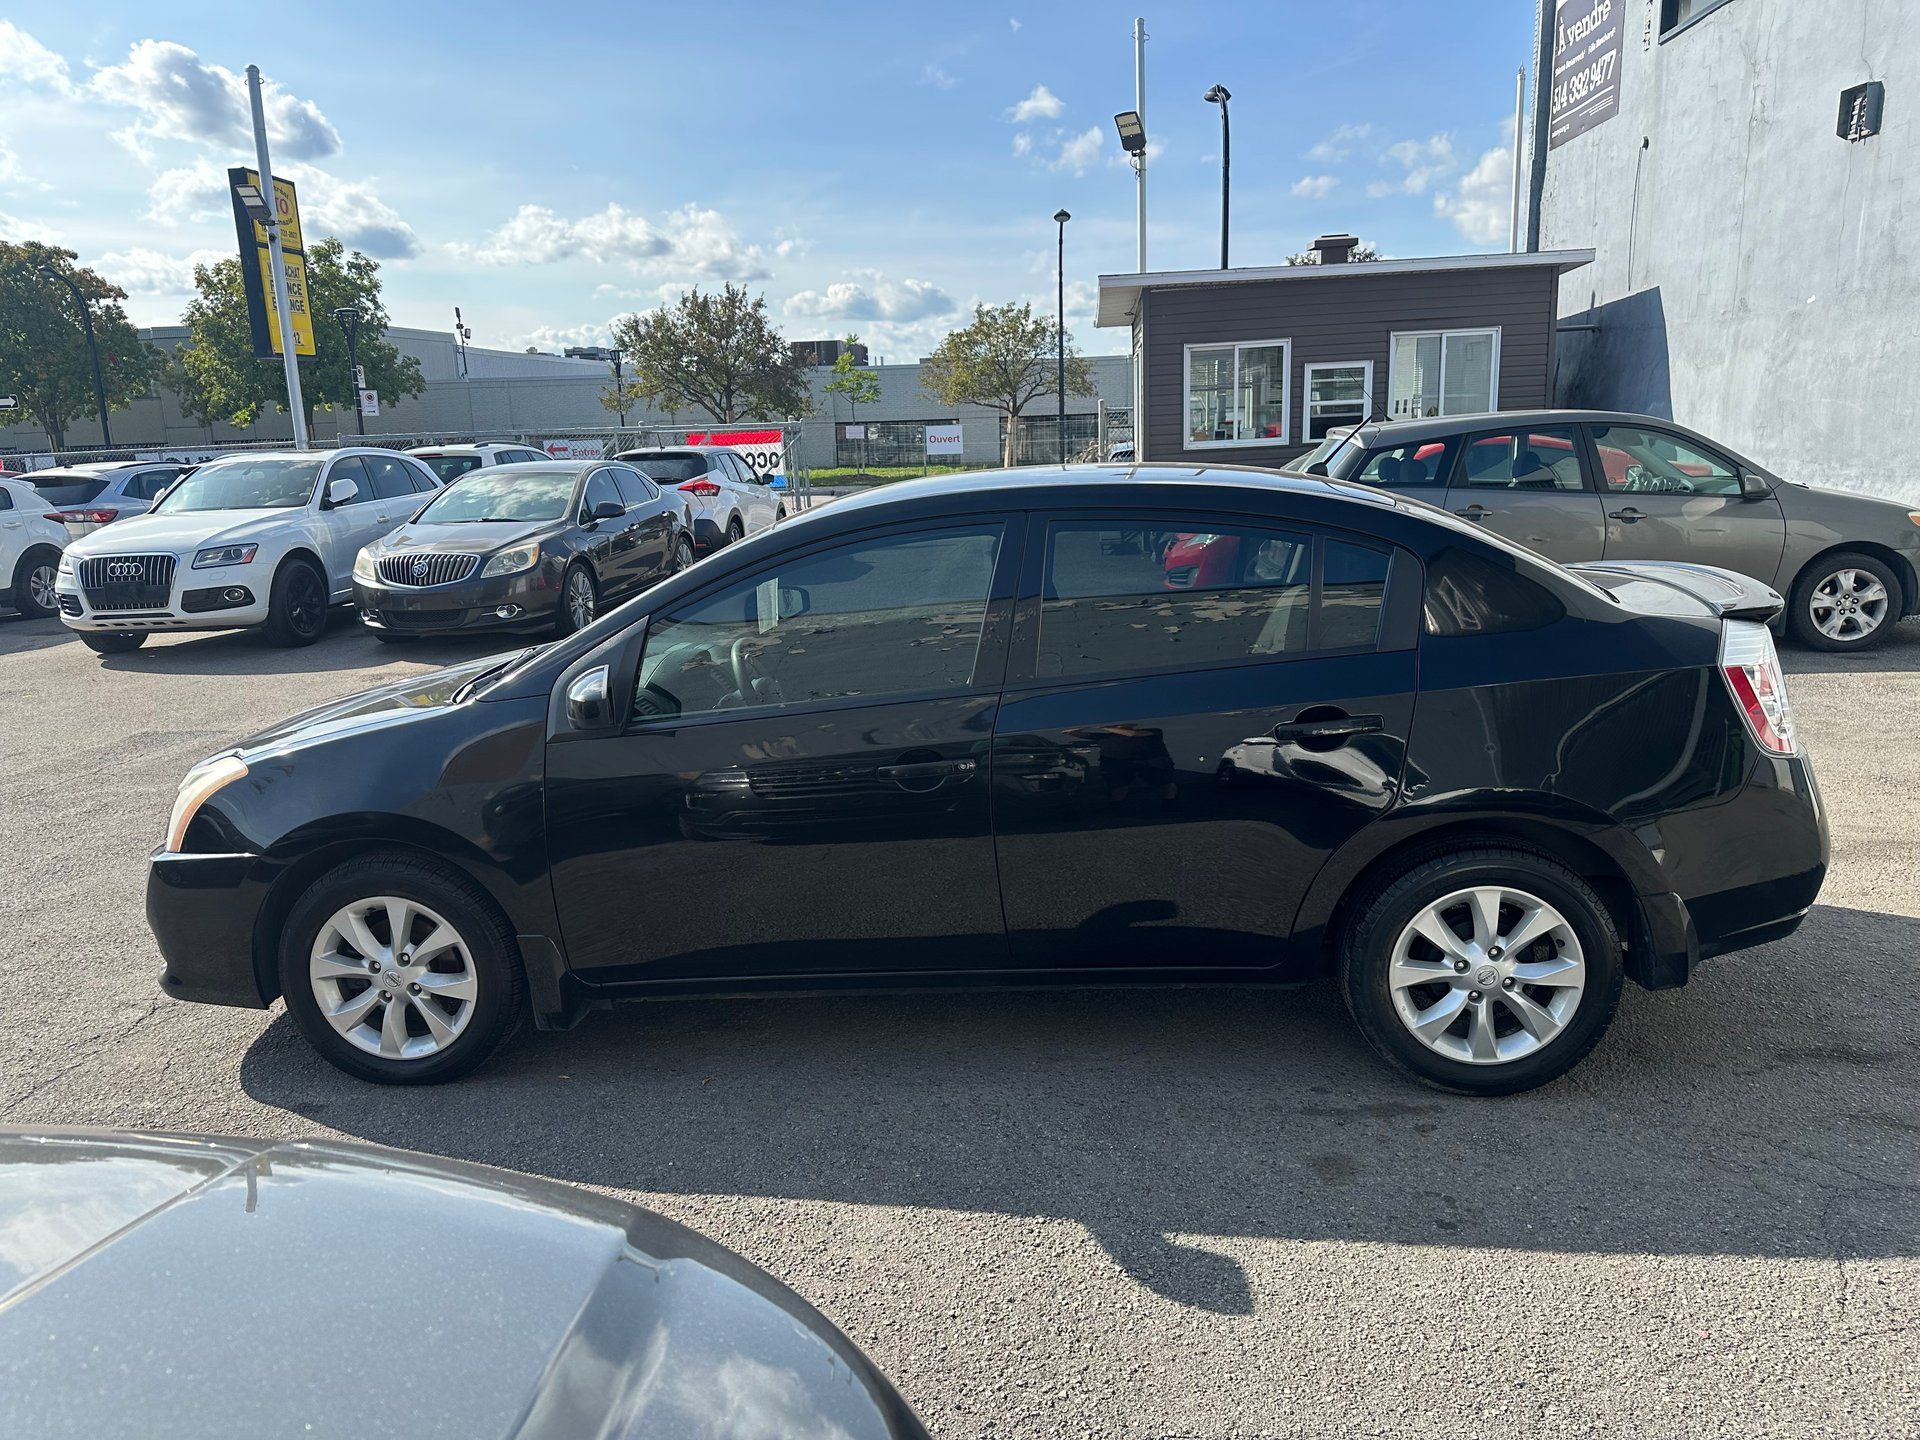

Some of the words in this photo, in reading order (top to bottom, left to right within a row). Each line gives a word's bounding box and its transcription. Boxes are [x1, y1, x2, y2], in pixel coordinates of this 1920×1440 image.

[1567, 0, 1611, 46] vendre
[1553, 81, 1568, 114] 514
[1569, 68, 1589, 104] 392
[1590, 48, 1617, 91] 9477
[929, 435, 960, 444] Ouvert
